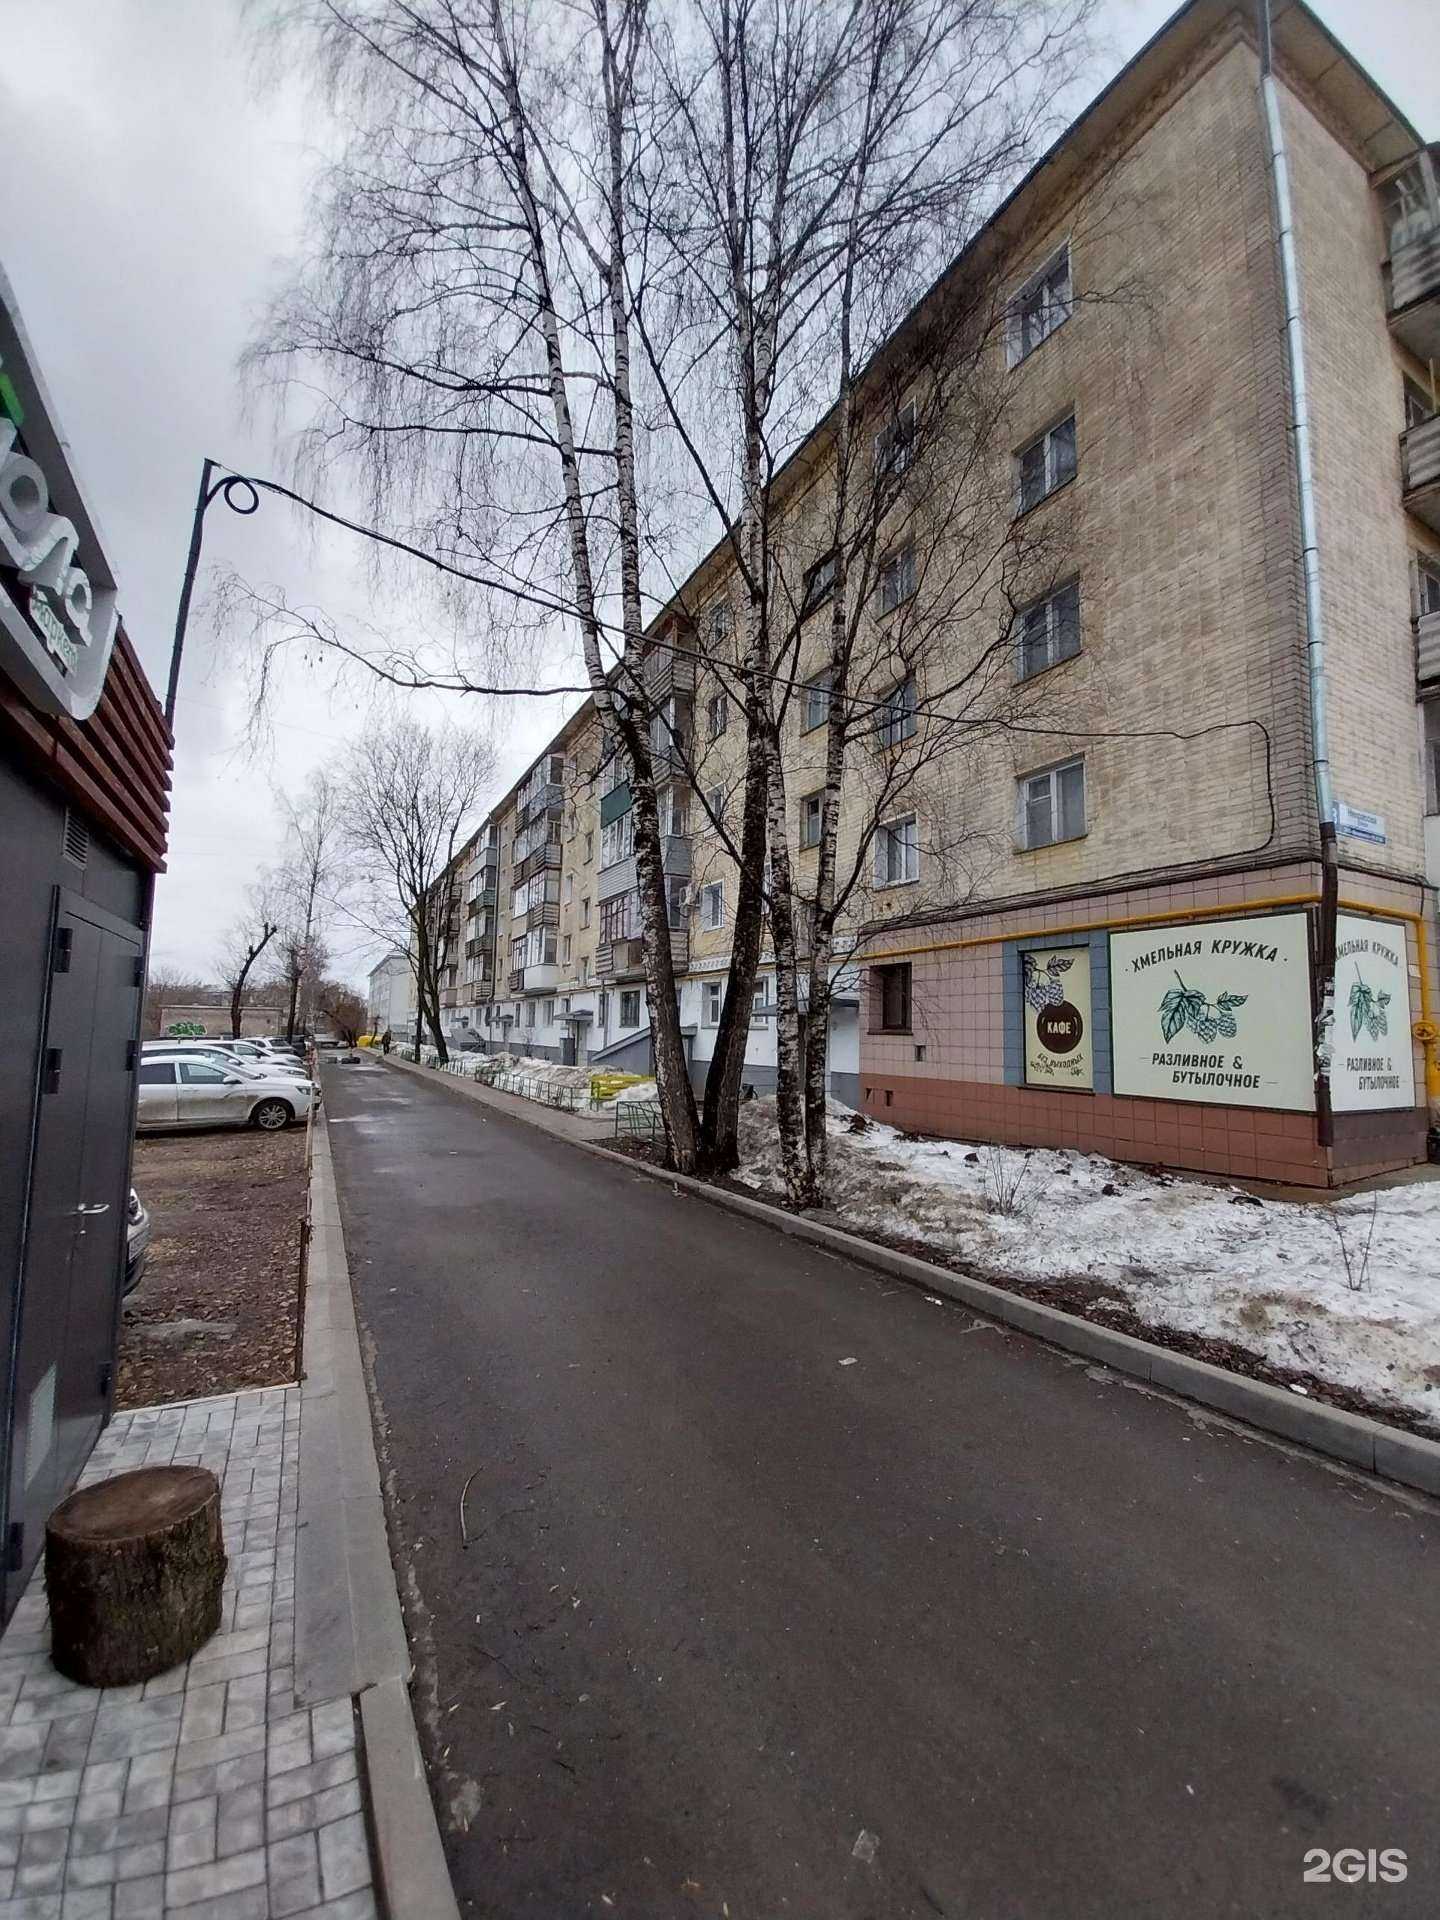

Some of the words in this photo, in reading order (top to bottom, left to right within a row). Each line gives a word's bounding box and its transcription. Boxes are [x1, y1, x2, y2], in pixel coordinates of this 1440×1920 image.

[1132, 940, 1202, 973] ХМЕЛЬНАЯ
[1211, 939, 1279, 962] КРУЖКА
[1047, 1020, 1072, 1035] КАФЕ
[1152, 1053, 1225, 1069] РАЗЛИВНОЕ
[1232, 1055, 1243, 1070] &
[1346, 1057, 1384, 1072] РАЗЛИВНОЕ
[1172, 1070, 1261, 1089] БУТЫЛОЧНОЕ
[1358, 1075, 1400, 1091] БУТЫЛОЧНОЕ
